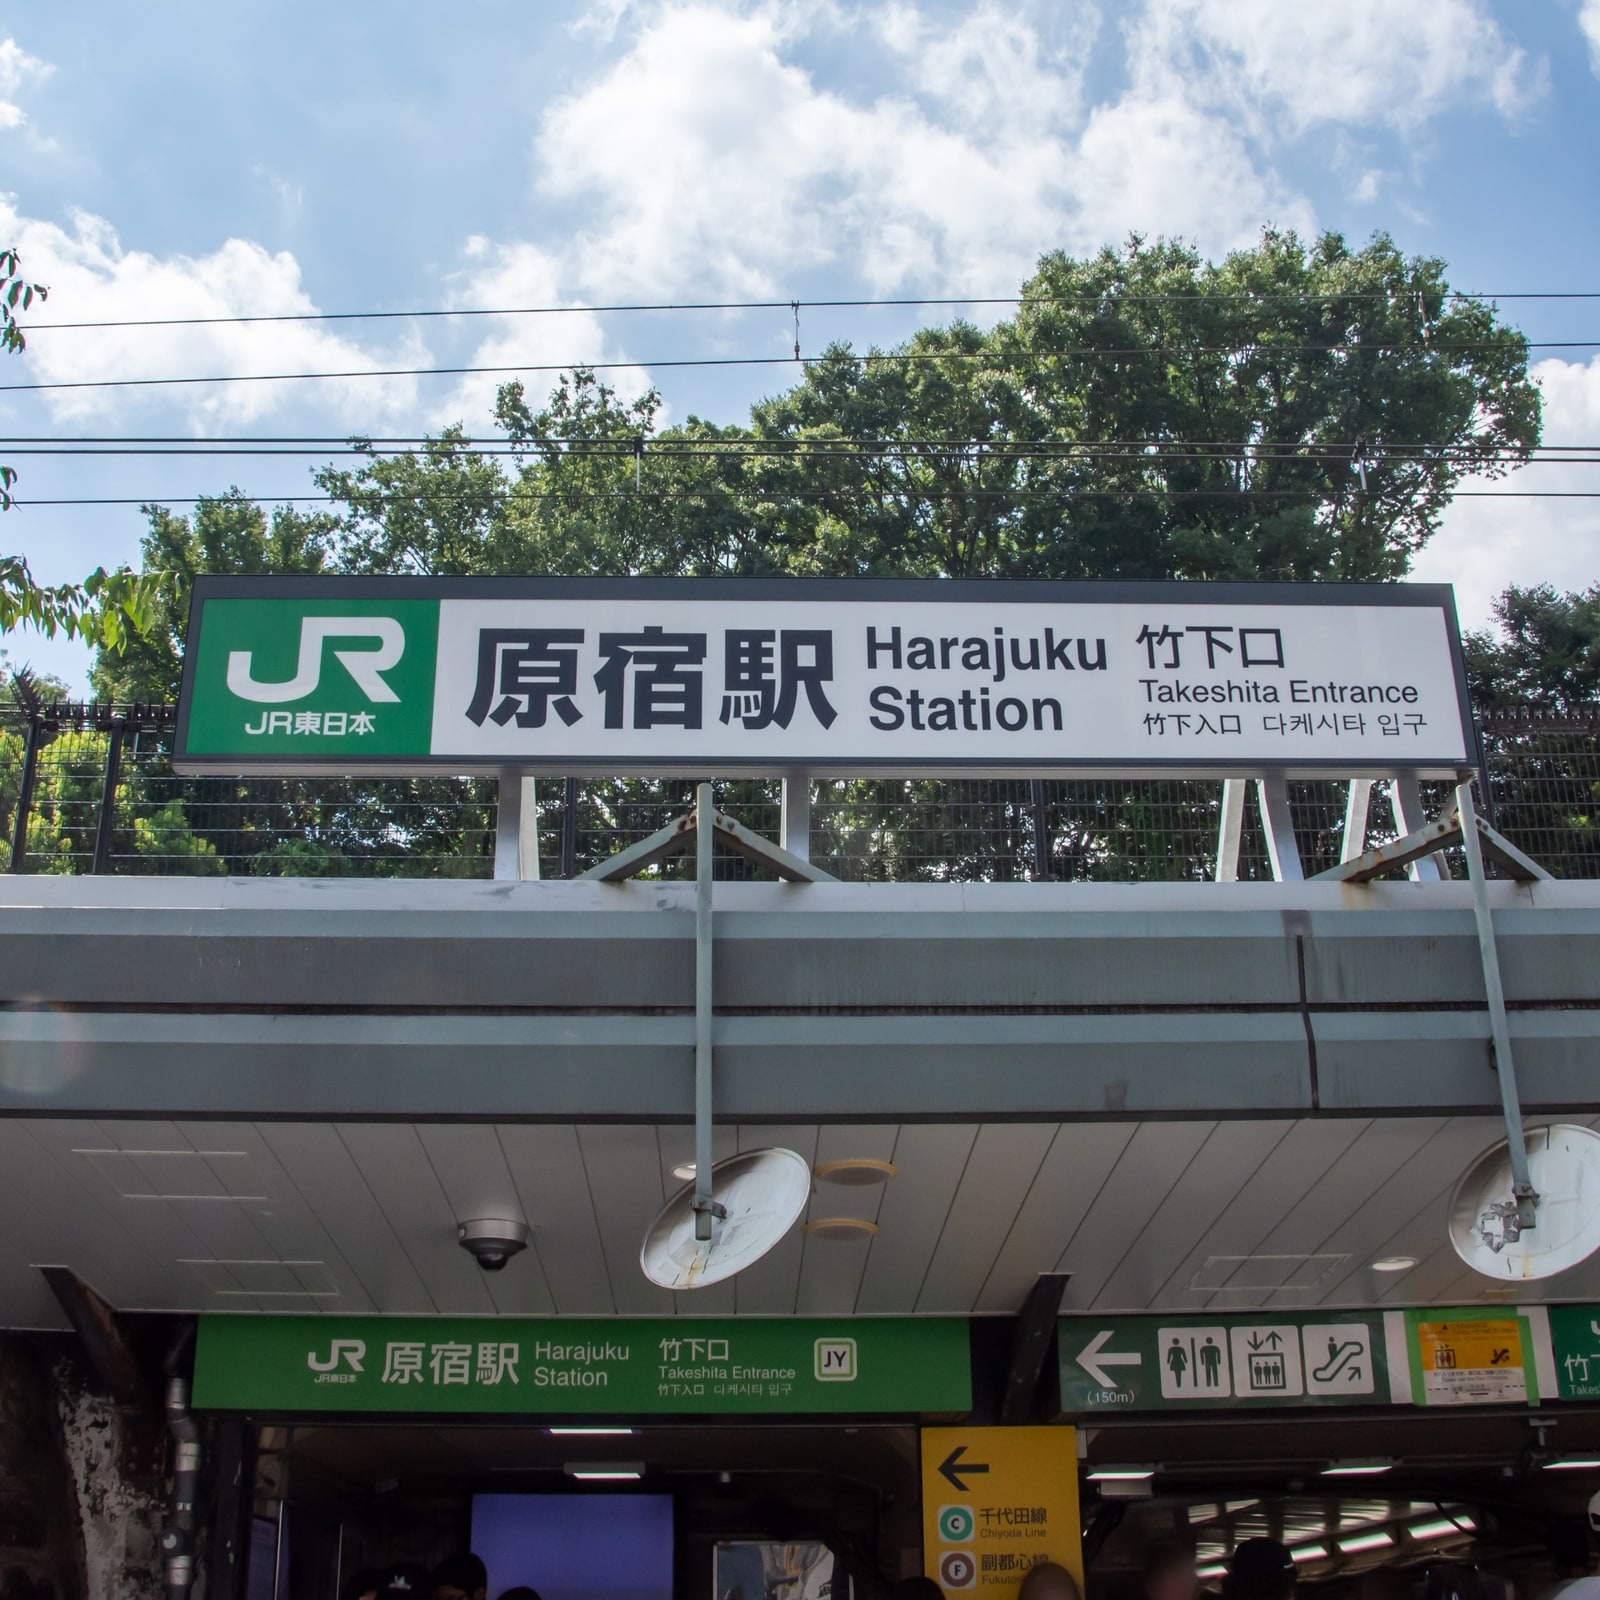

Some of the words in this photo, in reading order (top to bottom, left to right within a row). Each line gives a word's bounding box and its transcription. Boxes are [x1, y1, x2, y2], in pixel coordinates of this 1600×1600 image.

[866, 626, 1108, 683] Harajuku
[1135, 624, 1285, 670] 竹下口
[226, 616, 406, 704] JR
[464, 625, 838, 731] 原宿駅
[1138, 679, 1281, 703] Takeshita
[1289, 680, 1418, 704] Entrance
[869, 685, 1063, 732] Station
[243, 710, 376, 736] JR東日本
[1142, 712, 1242, 736] 竹下入口
[1262, 712, 1366, 736] 다케시타
[1377, 712, 1428, 736] 입구
[307, 1339, 367, 1372] JR
[534, 1341, 630, 1365] Harajuku
[658, 1337, 729, 1362] 竹下口
[823, 1350, 847, 1368] JY
[381, 1340, 520, 1385] 原宿駅
[658, 1366, 728, 1380] Takeshita
[732, 1366, 796, 1380] Entrance
[1564, 1353, 1600, 1382] 竹
[313, 1373, 357, 1384] JR東日本
[534, 1367, 608, 1386] Station
[657, 1383, 705, 1396] 竹下入口
[713, 1383, 763, 1396] 다케시타
[768, 1383, 793, 1396] 입구
[1086, 1390, 1135, 1406] (150m)
[1569, 1383, 1600, 1396] Takes
[951, 1517, 960, 1530] C
[979, 1507, 1048, 1526] 千代田線
[980, 1527, 1022, 1541] Chiyoda
[1025, 1527, 1047, 1538] Line
[954, 1564, 962, 1577] F
[982, 1575, 1025, 1585] Fukutos
